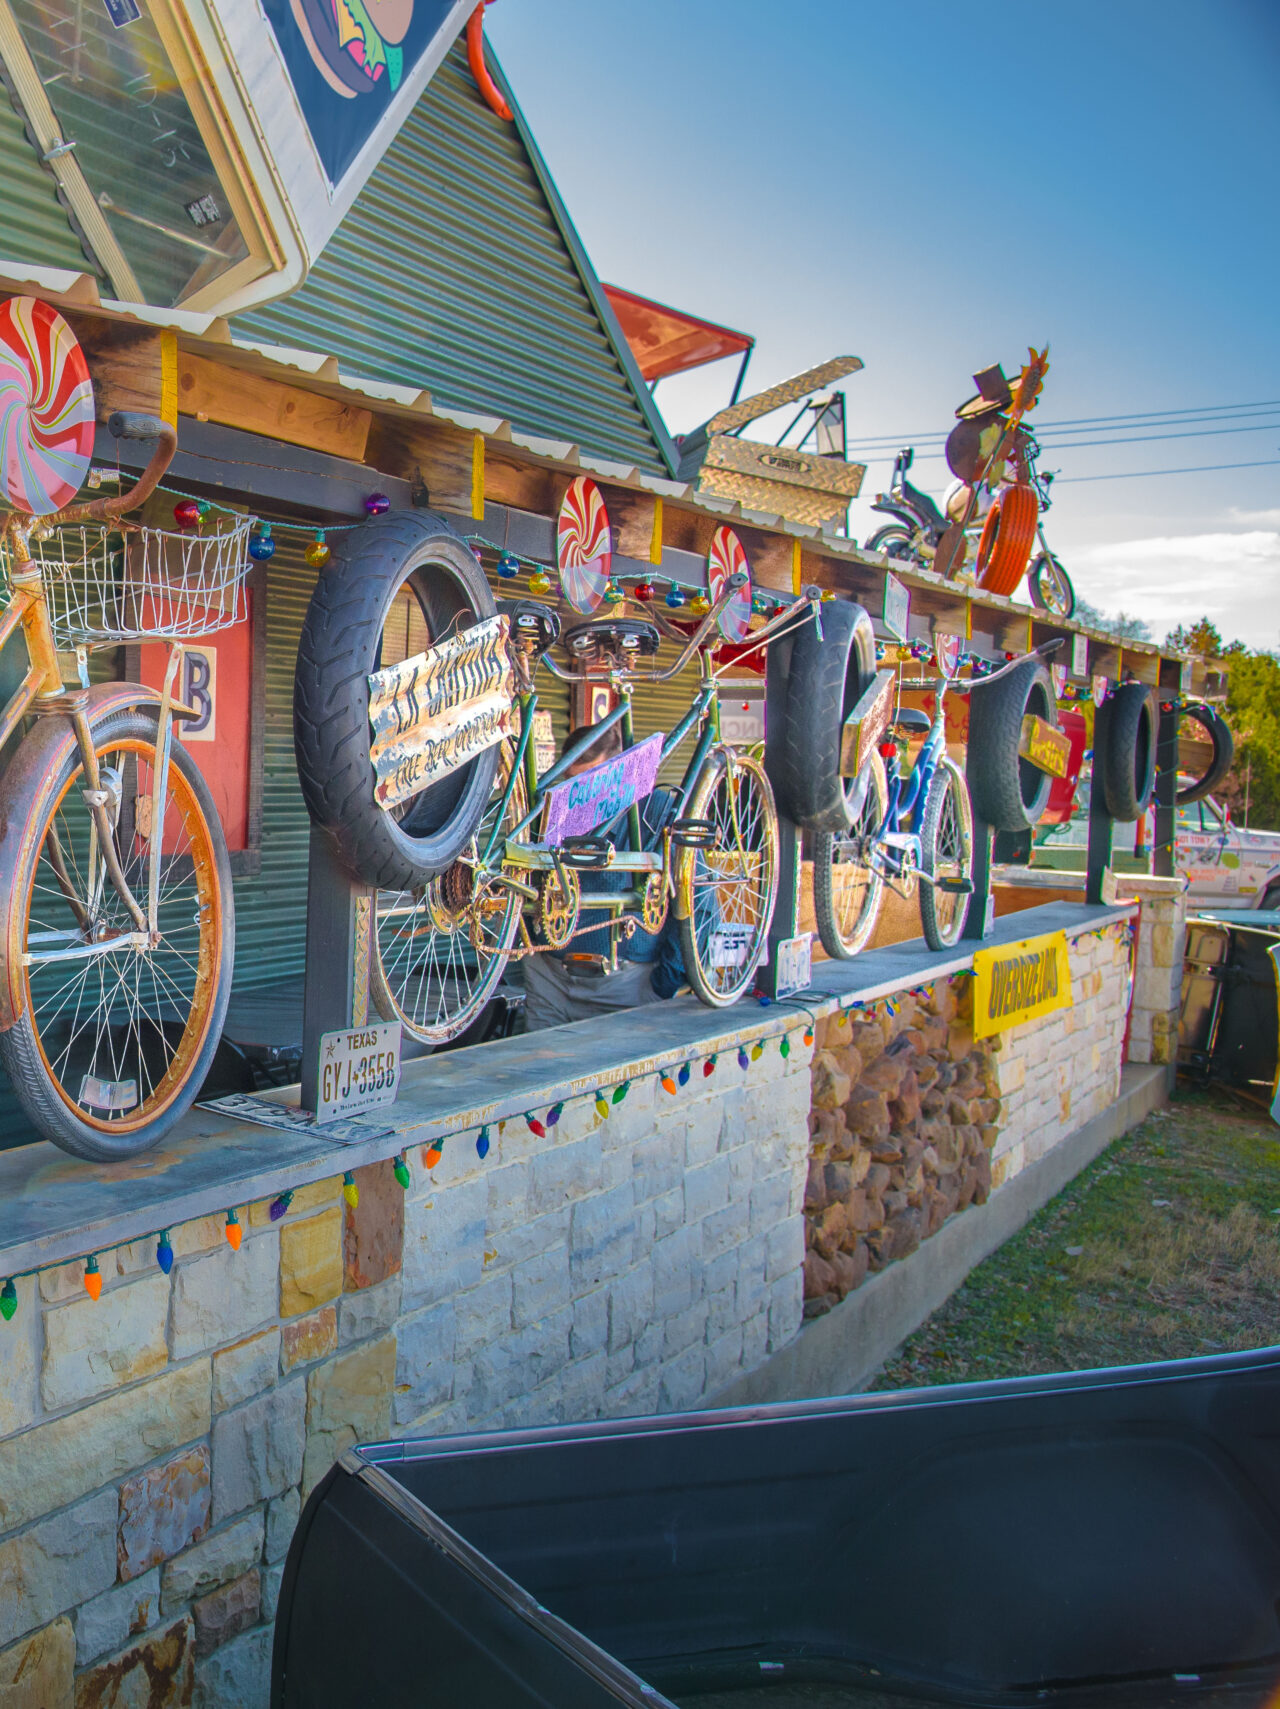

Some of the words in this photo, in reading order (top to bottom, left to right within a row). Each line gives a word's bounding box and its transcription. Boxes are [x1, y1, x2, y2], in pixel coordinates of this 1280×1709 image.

[181, 651, 213, 733] B
[394, 752, 422, 793] FREE
[424, 738, 455, 775] BEER
[347, 1030, 378, 1051] TEXAS
